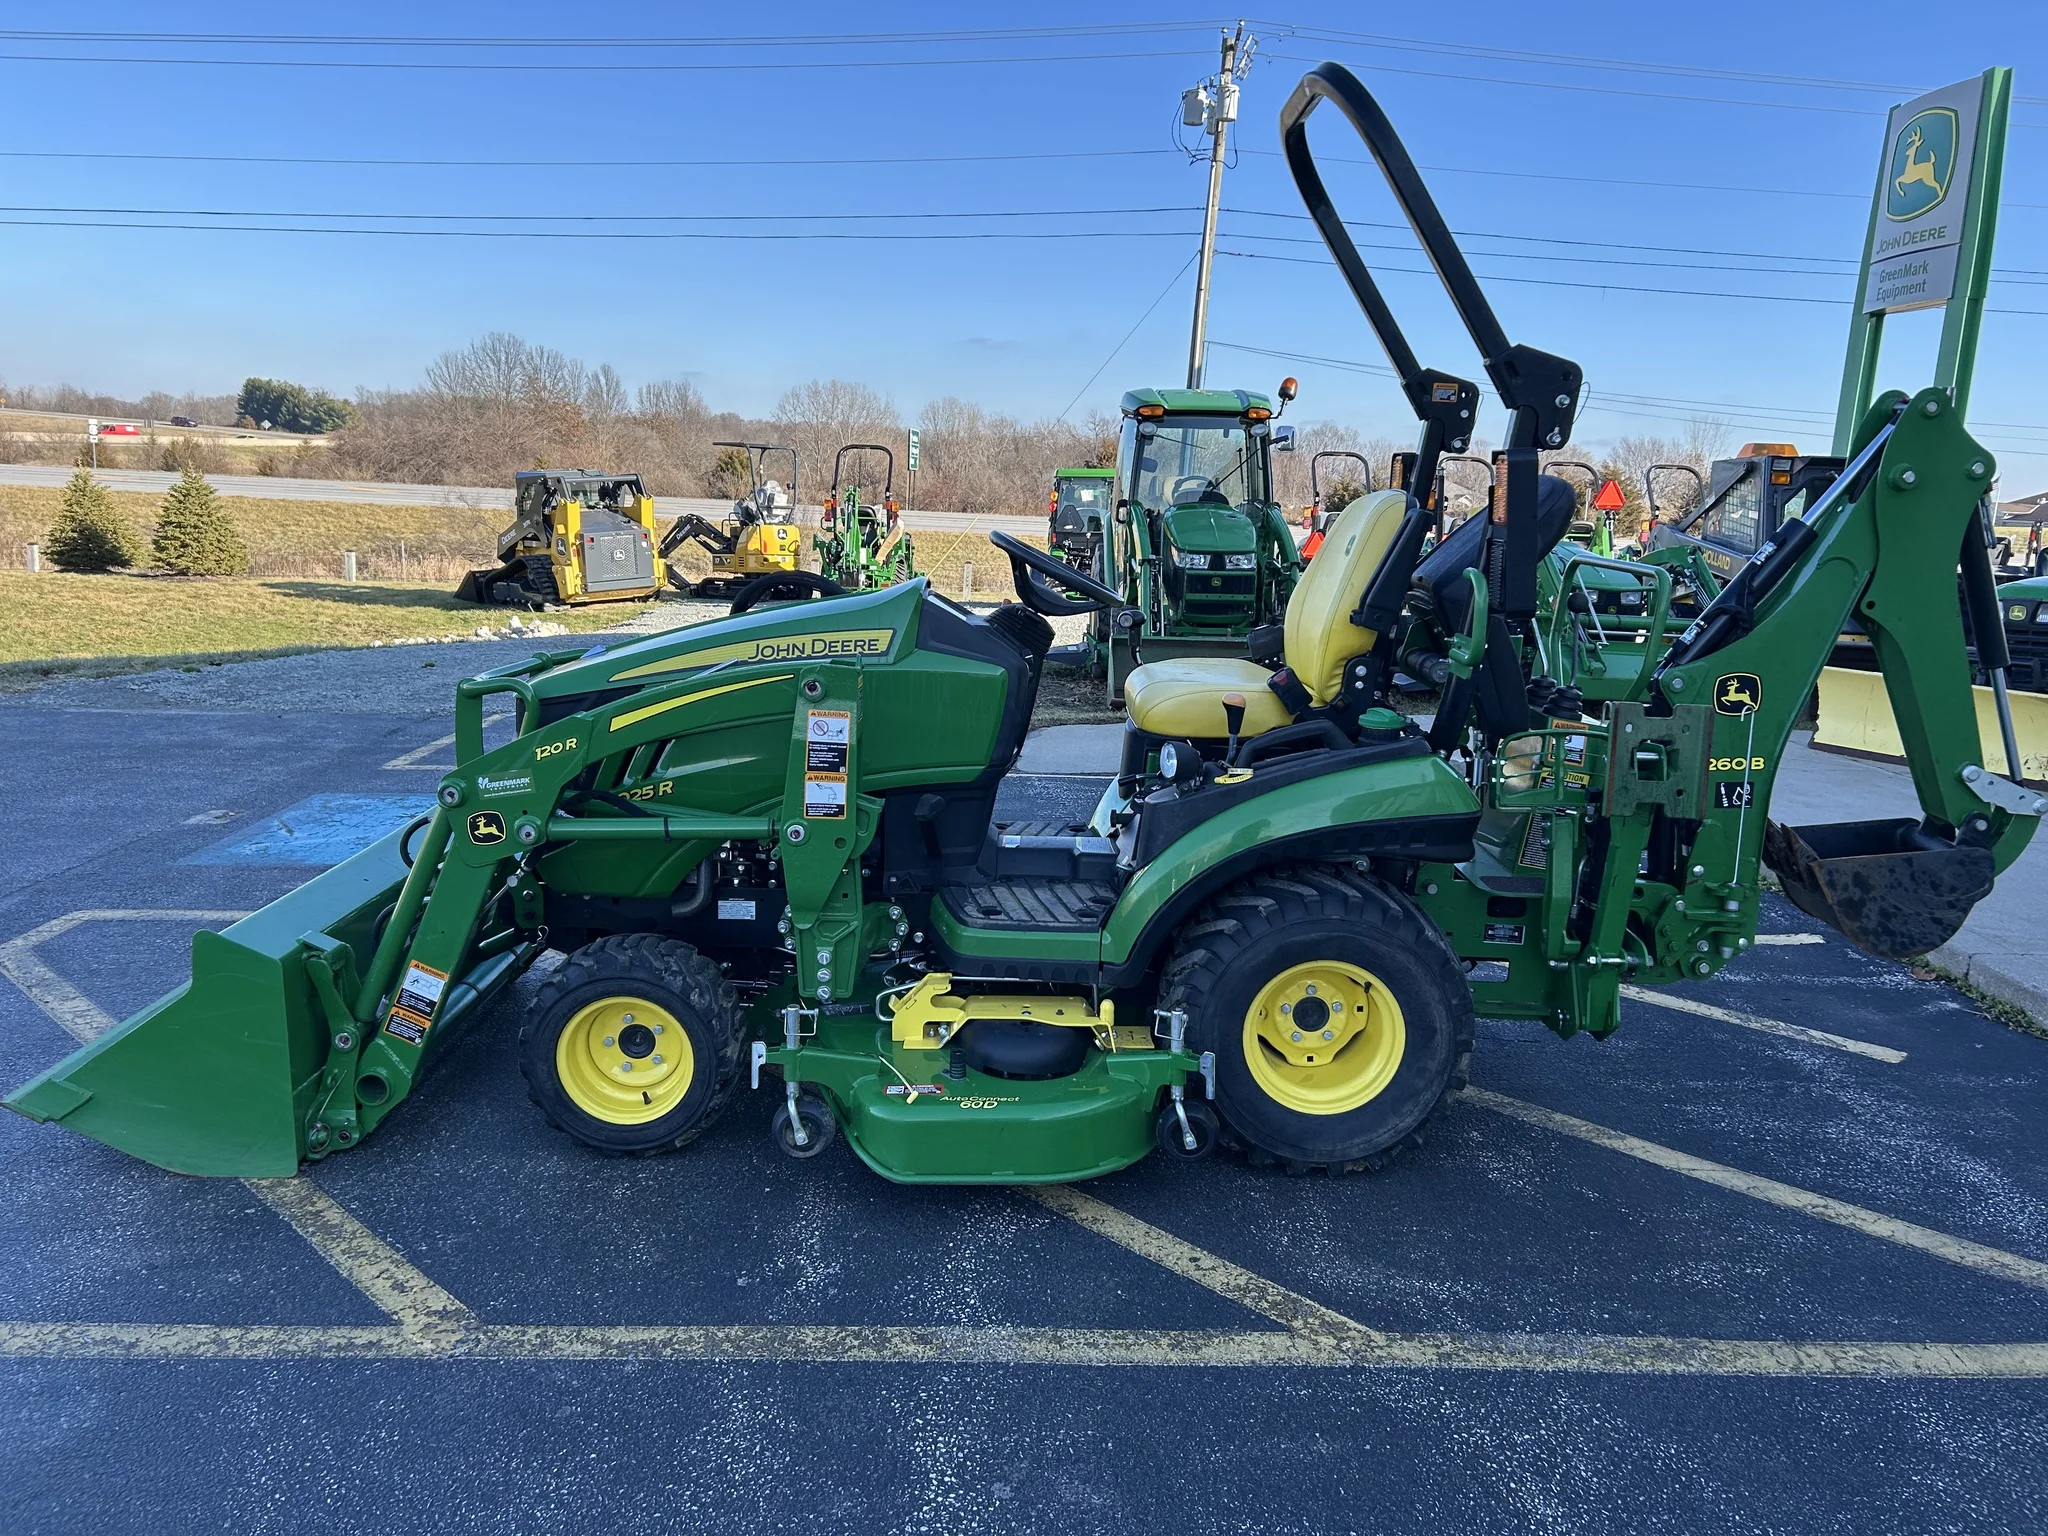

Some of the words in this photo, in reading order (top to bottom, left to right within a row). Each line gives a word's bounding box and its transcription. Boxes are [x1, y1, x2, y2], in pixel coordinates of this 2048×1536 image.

[1876, 236, 1902, 255] JOHN
[1902, 226, 1947, 247] DEERE
[1879, 260, 1929, 284] GreenMark
[1876, 279, 1927, 303] Equipment
[501, 528, 517, 545] DEERE
[748, 642, 806, 660] JOHN
[811, 638, 880, 655] DEERE
[816, 710, 849, 718] WARNING
[535, 742, 564, 761] 120
[565, 738, 578, 752] R
[1708, 757, 1748, 771] 260
[1750, 757, 1765, 770] B
[486, 777, 531, 789] GREENMARK
[813, 774, 846, 782] WARNING
[658, 781, 674, 796] R
[420, 964, 445, 979] WARNING
[402, 1012, 426, 1027] WARNING
[960, 1101, 998, 1109] 60D
